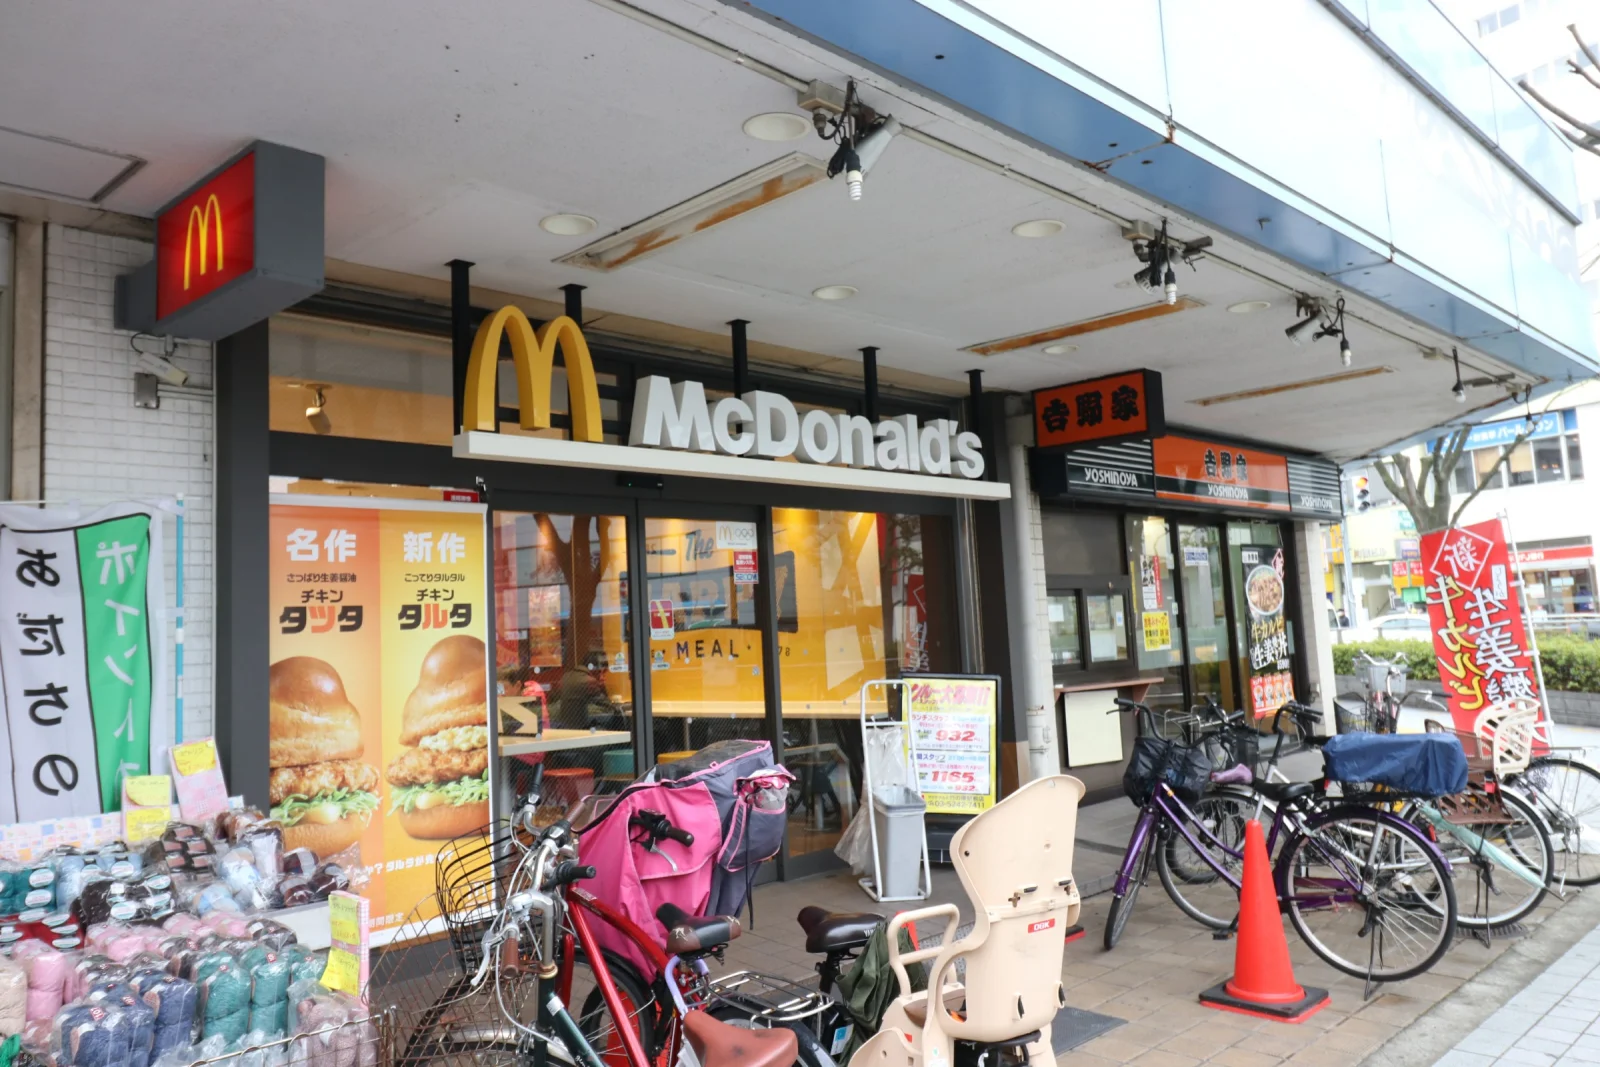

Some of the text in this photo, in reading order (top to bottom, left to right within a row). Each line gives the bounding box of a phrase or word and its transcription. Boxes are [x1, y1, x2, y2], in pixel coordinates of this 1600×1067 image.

[1041, 385, 1139, 433] 吉野家
[629, 375, 985, 480] McDonald's
[286, 528, 357, 563] 名作
[403, 532, 466, 564] 新作
[286, 572, 357, 583] さっぱり生姜醤油
[404, 573, 466, 582] こってりタルタル
[301, 588, 344, 604] チキン
[416, 588, 455, 602] チキン
[279, 605, 363, 635] タツタ
[398, 603, 472, 630] タルタ
[677, 639, 739, 660] MEAL
[935, 730, 975, 742] 932
